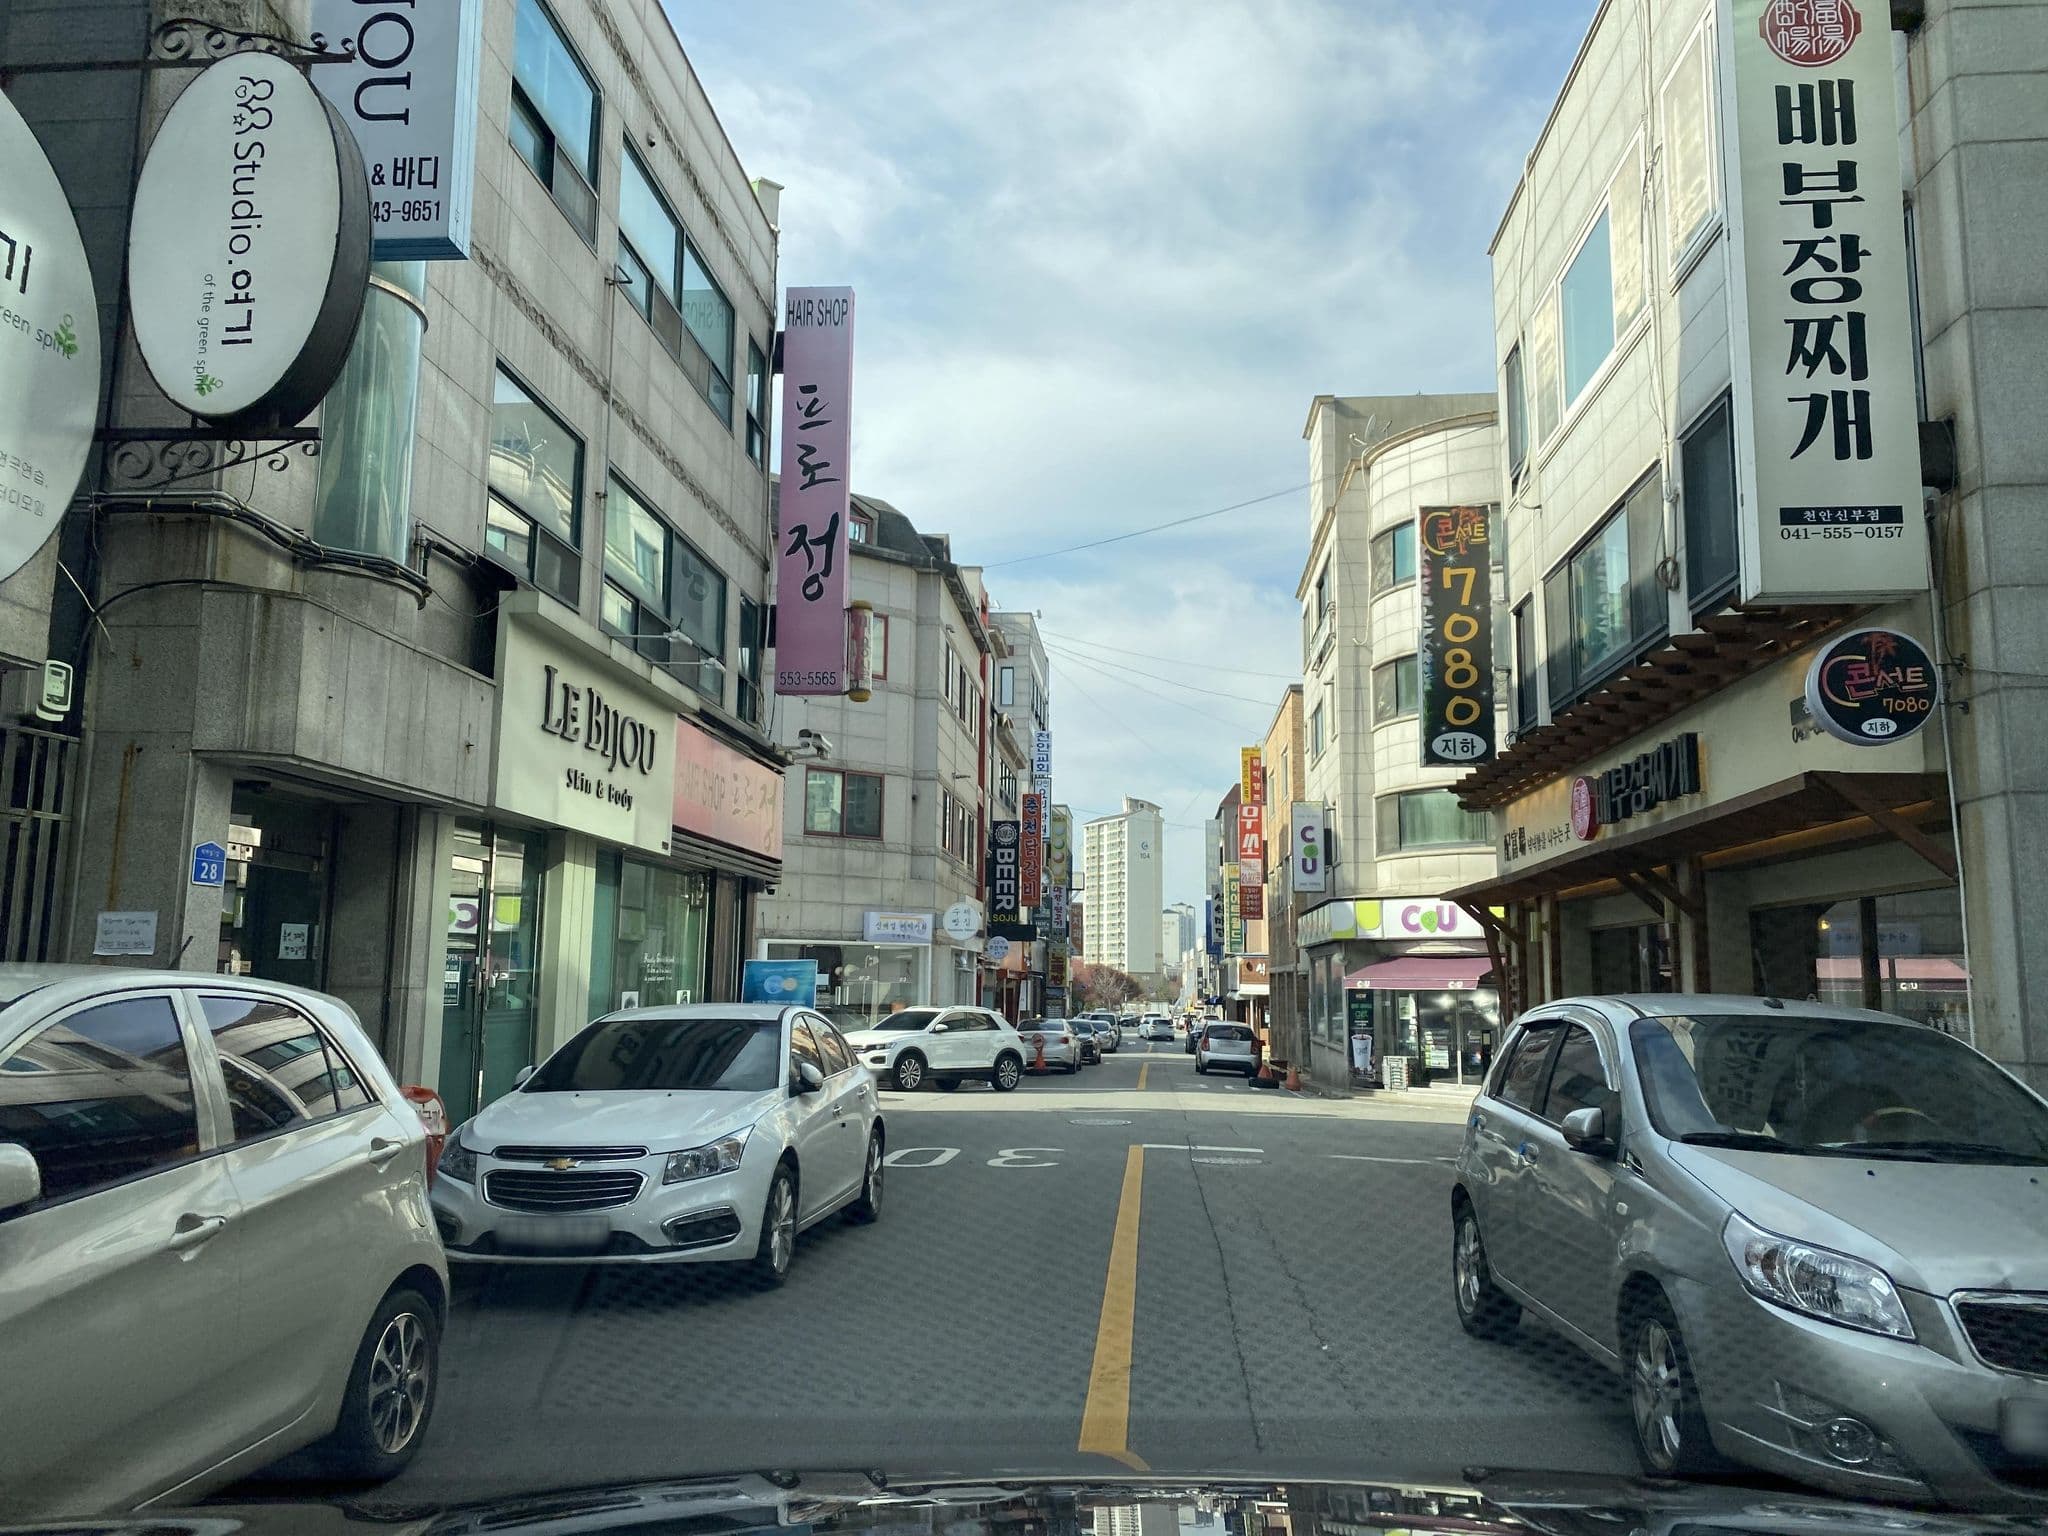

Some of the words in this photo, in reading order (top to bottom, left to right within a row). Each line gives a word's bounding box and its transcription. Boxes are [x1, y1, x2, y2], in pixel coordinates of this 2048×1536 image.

[371, 163, 386, 185] &
[392, 156, 439, 189] 바디
[203, 273, 216, 286] of
[1775, 78, 1874, 461] 배부장찌개
[201, 291, 215, 313] the
[787, 299, 814, 327] HAIR
[817, 298, 848, 327] SHOP
[197, 317, 209, 354] green
[785, 384, 841, 602] 프로정
[1803, 509, 1880, 522] 천안신부점
[1780, 526, 1904, 540] 041-555-0157
[1443, 567, 1481, 726] 7080
[779, 671, 837, 686] 553-5565
[1883, 697, 1930, 714] 7080
[542, 665, 581, 742] LE
[584, 687, 659, 777] BIJOU
[1868, 722, 1891, 733] 지하
[1441, 738, 1476, 756] 지하
[566, 768, 591, 795] Skin
[200, 862, 217, 880] 28
[996, 848, 1015, 910] BEER
[992, 914, 1017, 922] SOJU
[1401, 905, 1458, 933] CU
